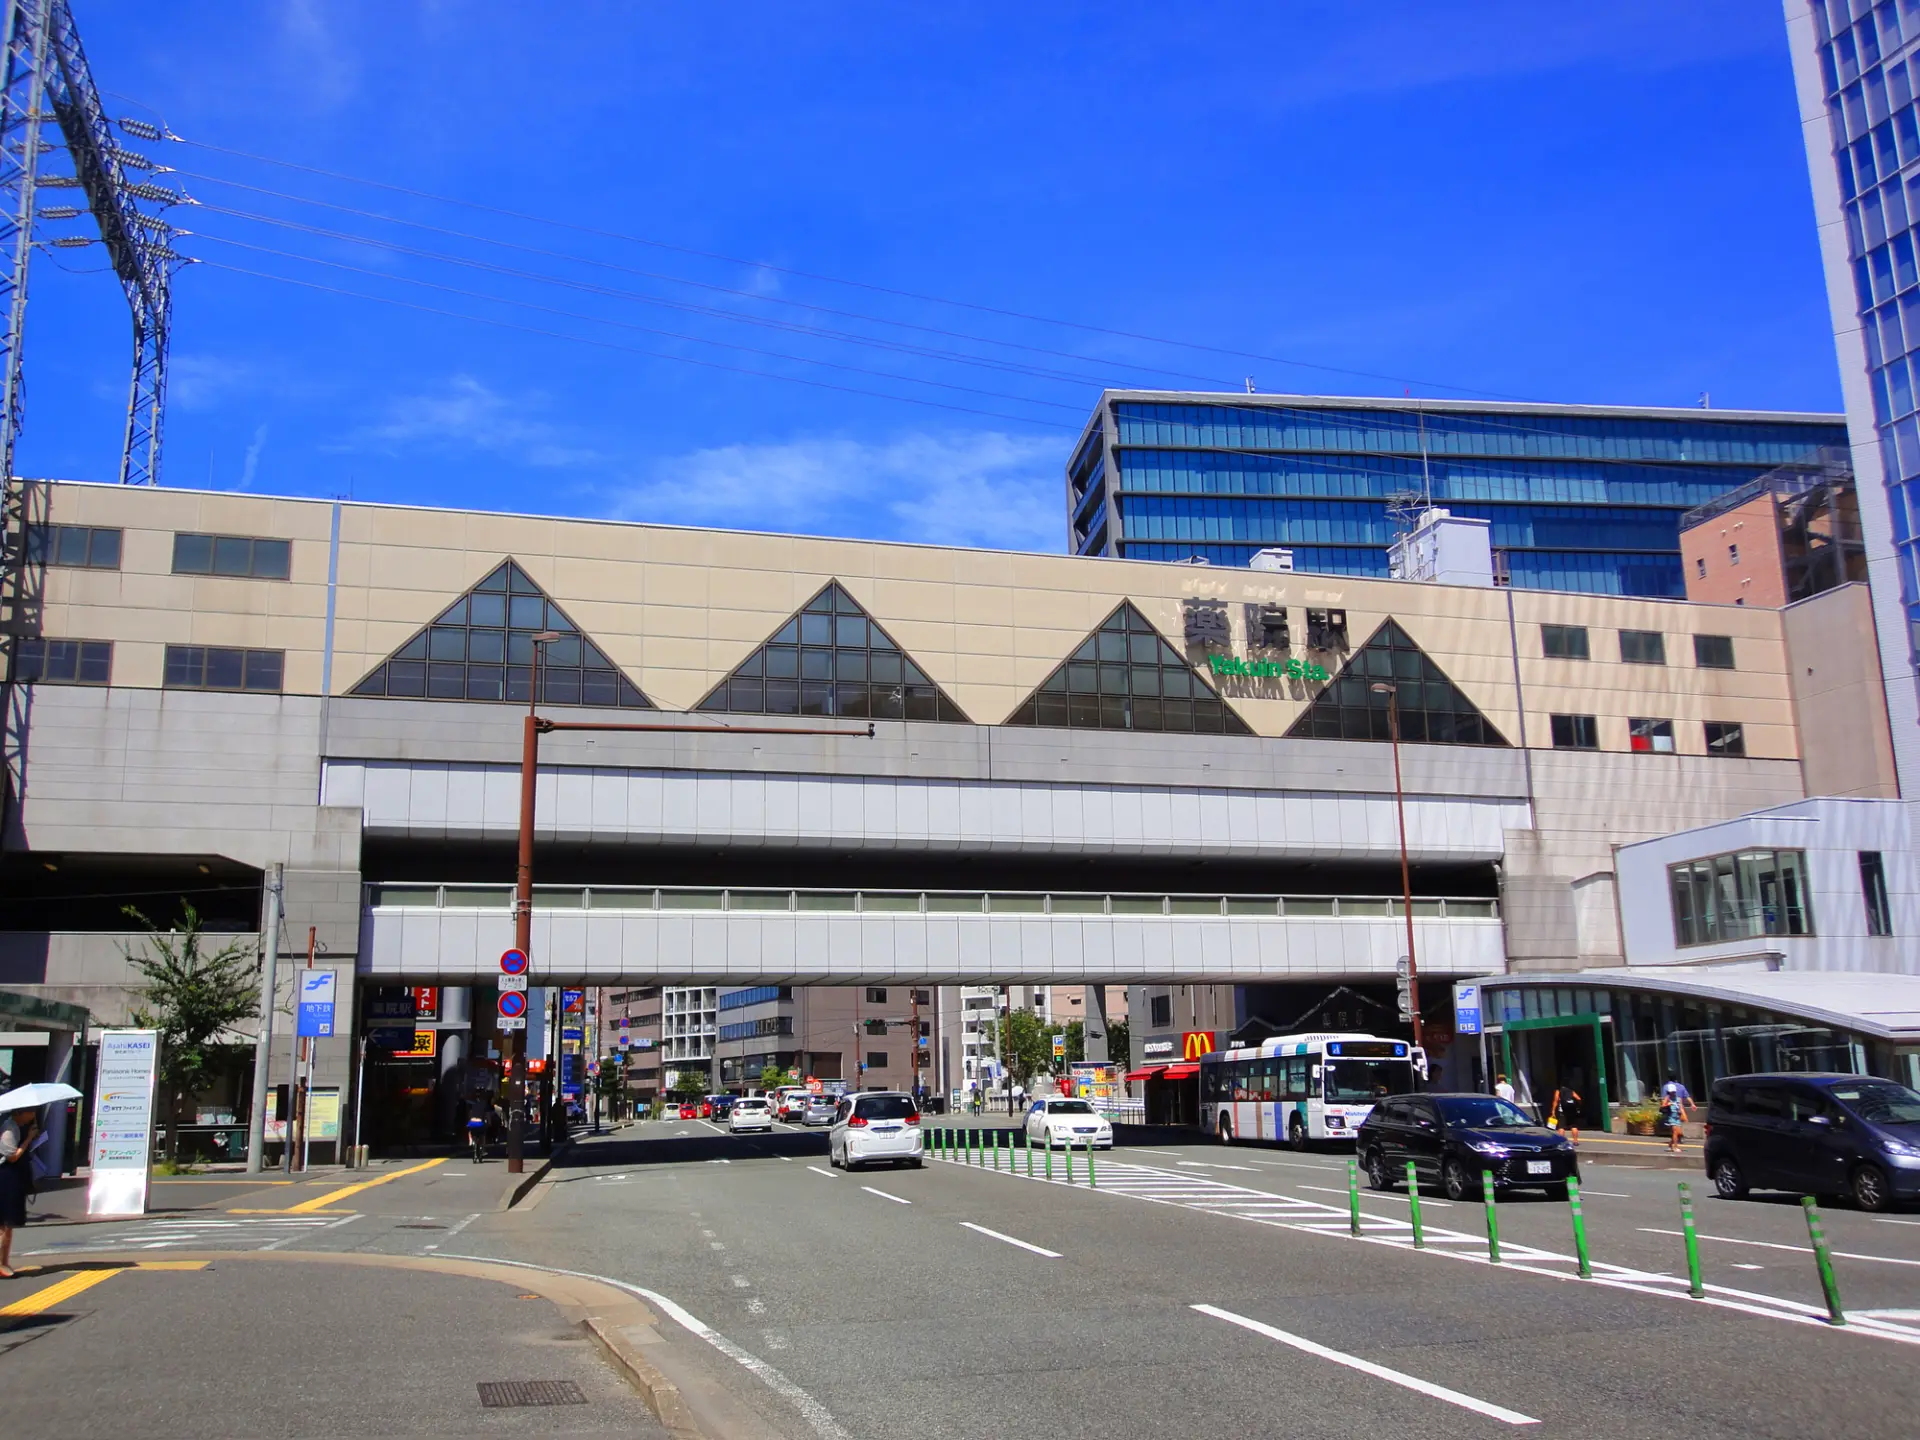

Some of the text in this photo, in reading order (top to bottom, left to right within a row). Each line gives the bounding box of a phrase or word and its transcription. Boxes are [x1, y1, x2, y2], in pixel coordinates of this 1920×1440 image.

[1182, 597, 1348, 651] 薬院駅
[1209, 655, 1330, 681] Yakuin Sta.
[306, 1004, 331, 1013] 地下鉄
[415, 1034, 431, 1051] 薬
